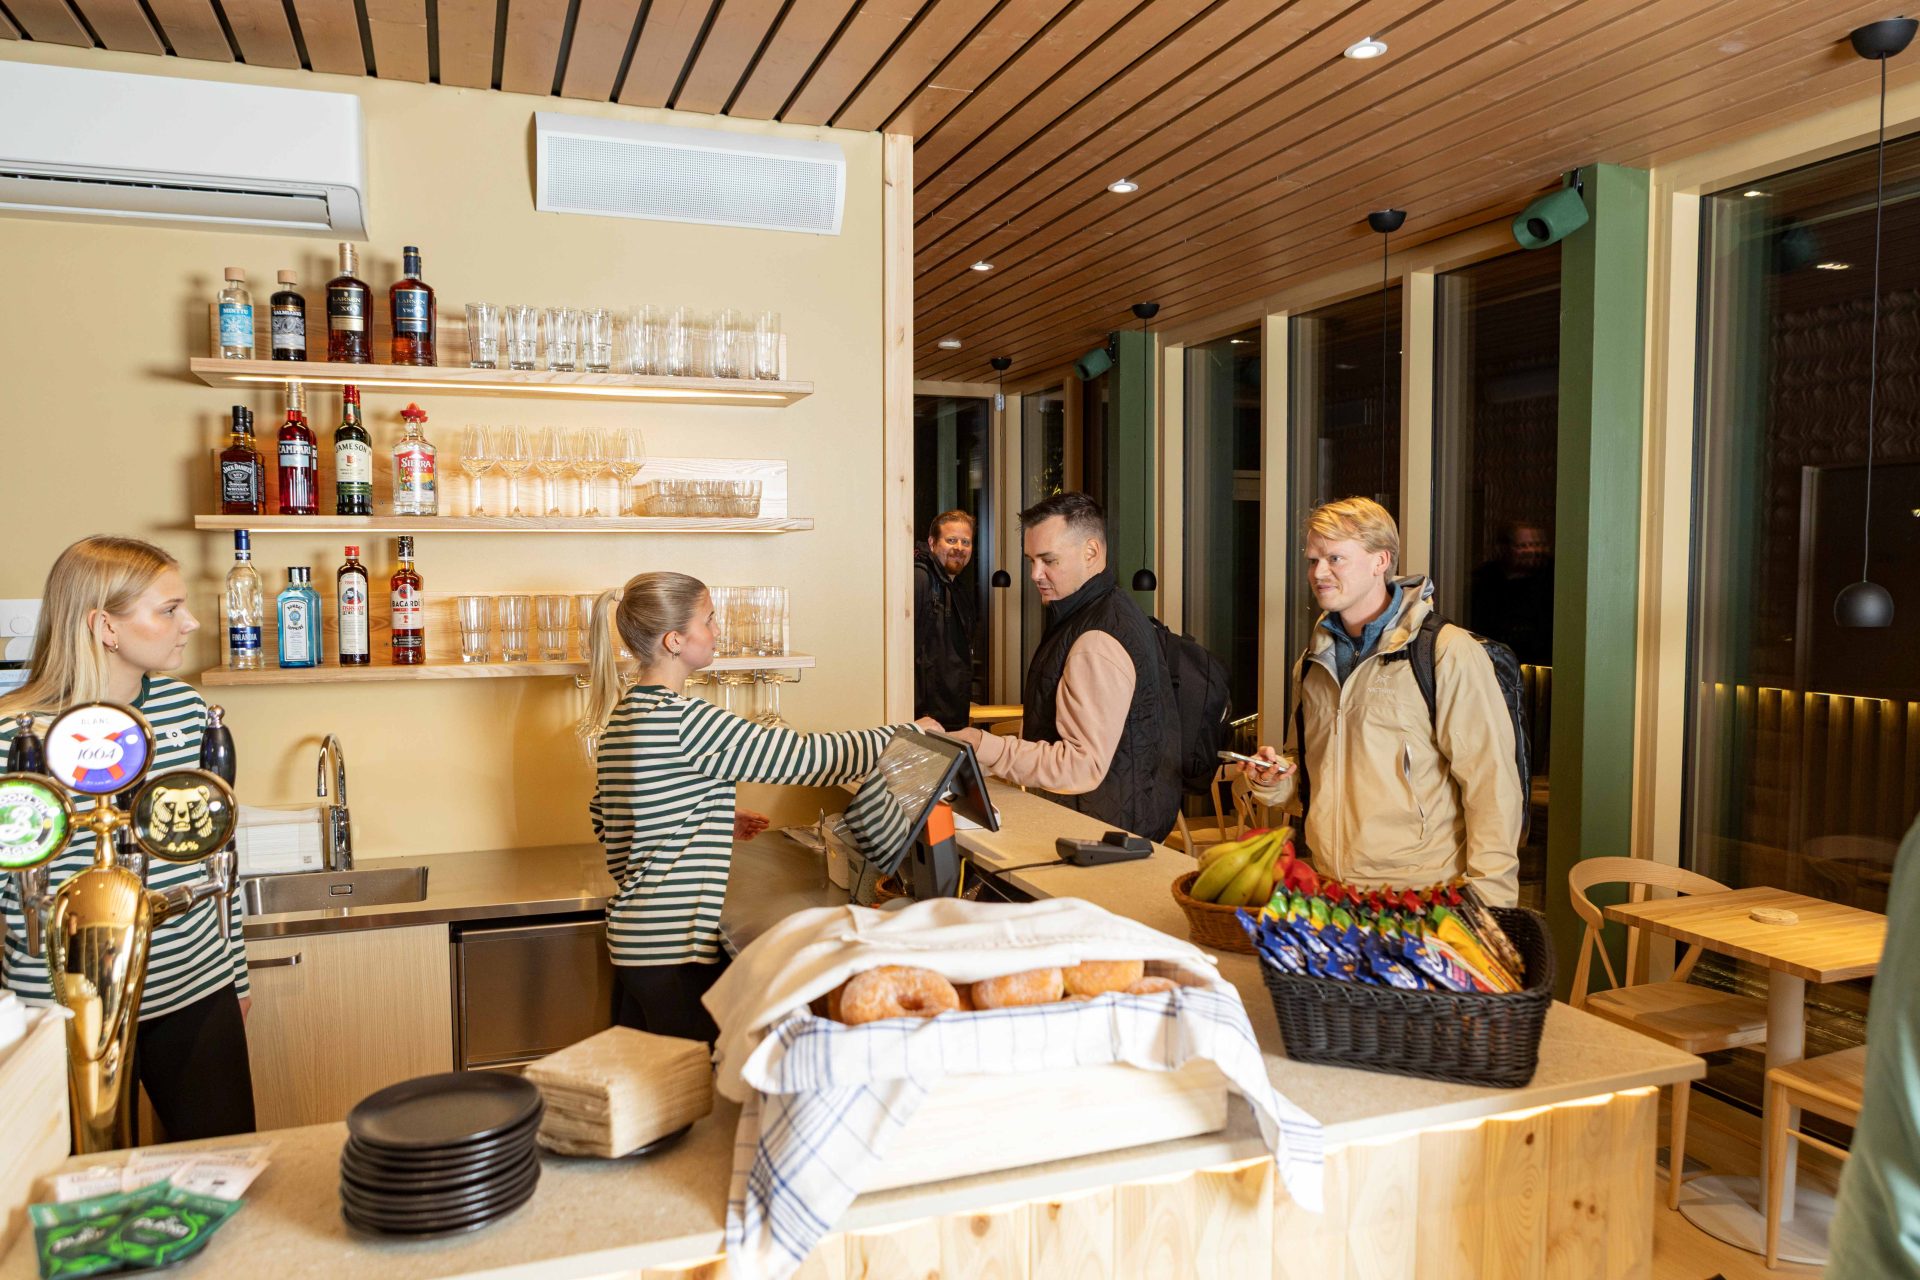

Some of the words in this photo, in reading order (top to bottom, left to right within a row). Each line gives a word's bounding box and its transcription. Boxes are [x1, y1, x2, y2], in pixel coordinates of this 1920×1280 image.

[278, 444, 312, 455] CAMPARI
[335, 442, 368, 454] JAMESON
[232, 633, 258, 641] FINLANDIA
[77, 747, 116, 760] 1664
